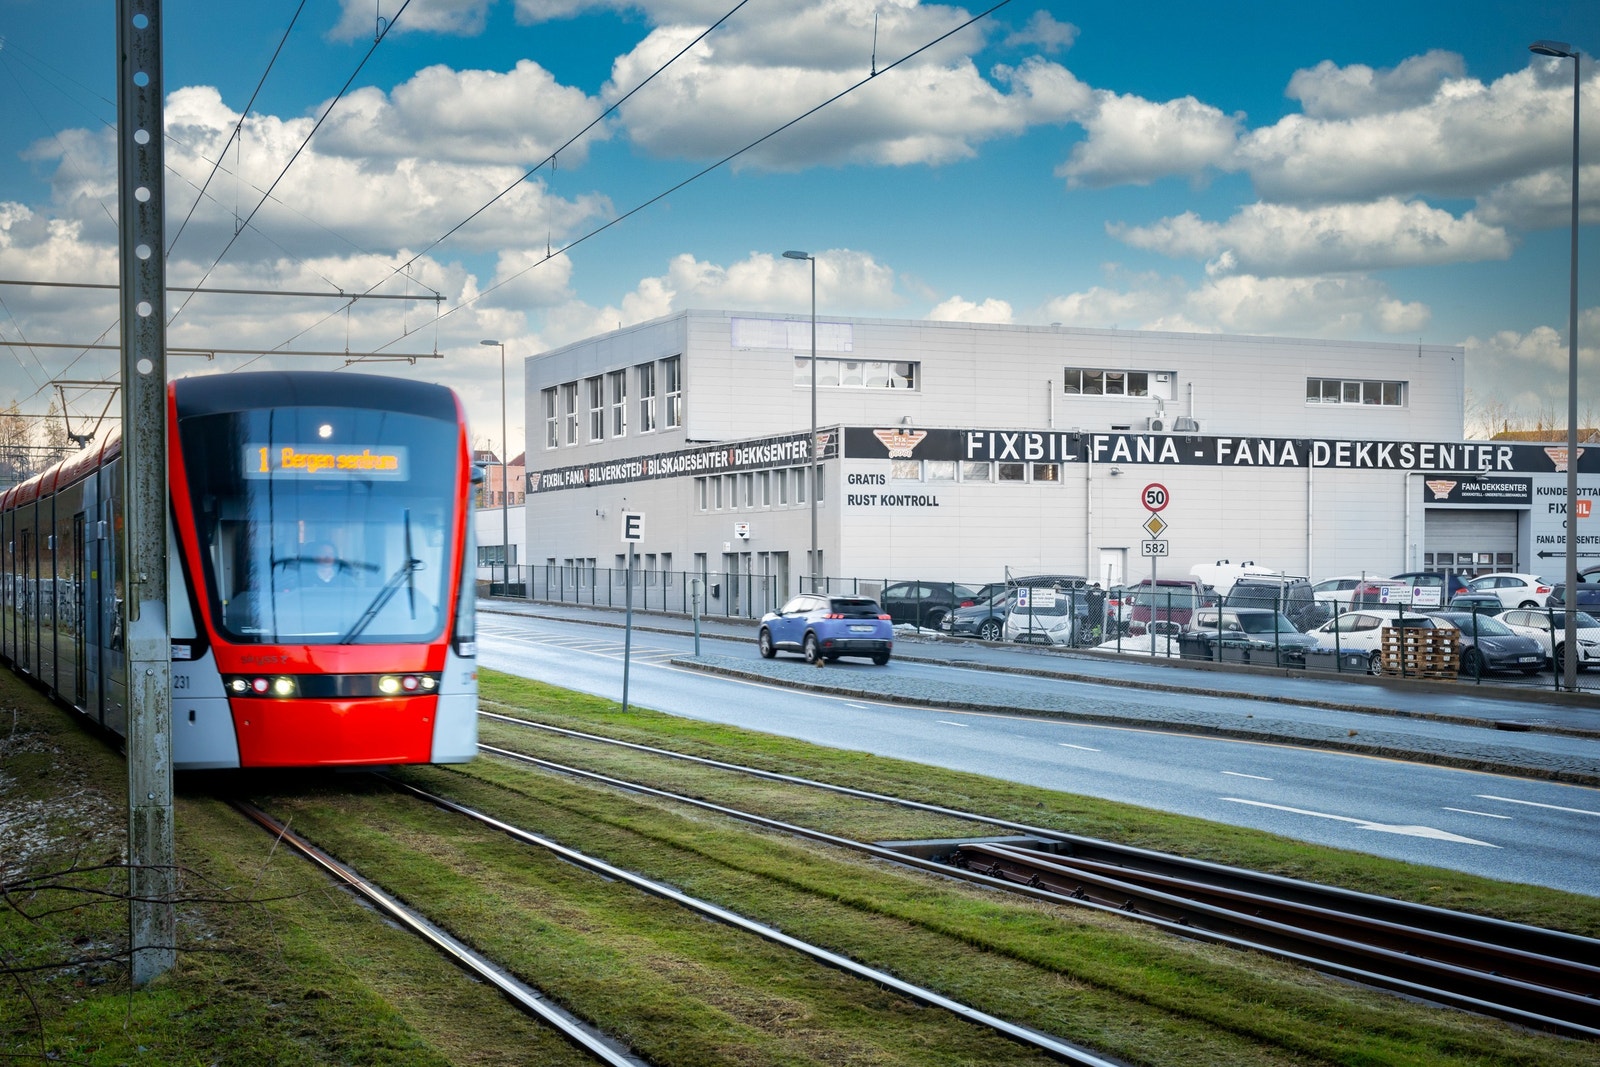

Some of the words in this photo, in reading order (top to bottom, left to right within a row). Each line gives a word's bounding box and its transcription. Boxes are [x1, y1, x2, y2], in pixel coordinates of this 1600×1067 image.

[967, 432, 1078, 461] FIXBIL
[1093, 435, 1180, 463] FANA
[1216, 438, 1299, 466] FANA
[1313, 441, 1514, 471] DEKKSENTER
[259, 447, 269, 472] 1
[281, 447, 335, 473] Bergen
[542, 473, 564, 489] FIXBIL
[565, 469, 585, 485] FANA
[589, 462, 642, 483] BILVERKSTED
[649, 450, 728, 476] BILSKADESENTER
[735, 440, 808, 465] DEKKSENTER
[847, 473, 886, 485] GRATIS
[1461, 483, 1480, 491] FANA
[1481, 483, 1527, 492] DEKKSENTER
[1536, 487, 1600, 497] KUNDEOTTA
[847, 494, 877, 506] RUST
[880, 495, 939, 507] KONTROLL
[1147, 490, 1165, 504] 50
[1548, 503, 1590, 514] FIXIL
[625, 515, 641, 539] E
[1536, 535, 1555, 544] FANA
[1557, 535, 1600, 544] DESENTE
[1145, 543, 1165, 553] 582
[173, 675, 190, 689] 231
